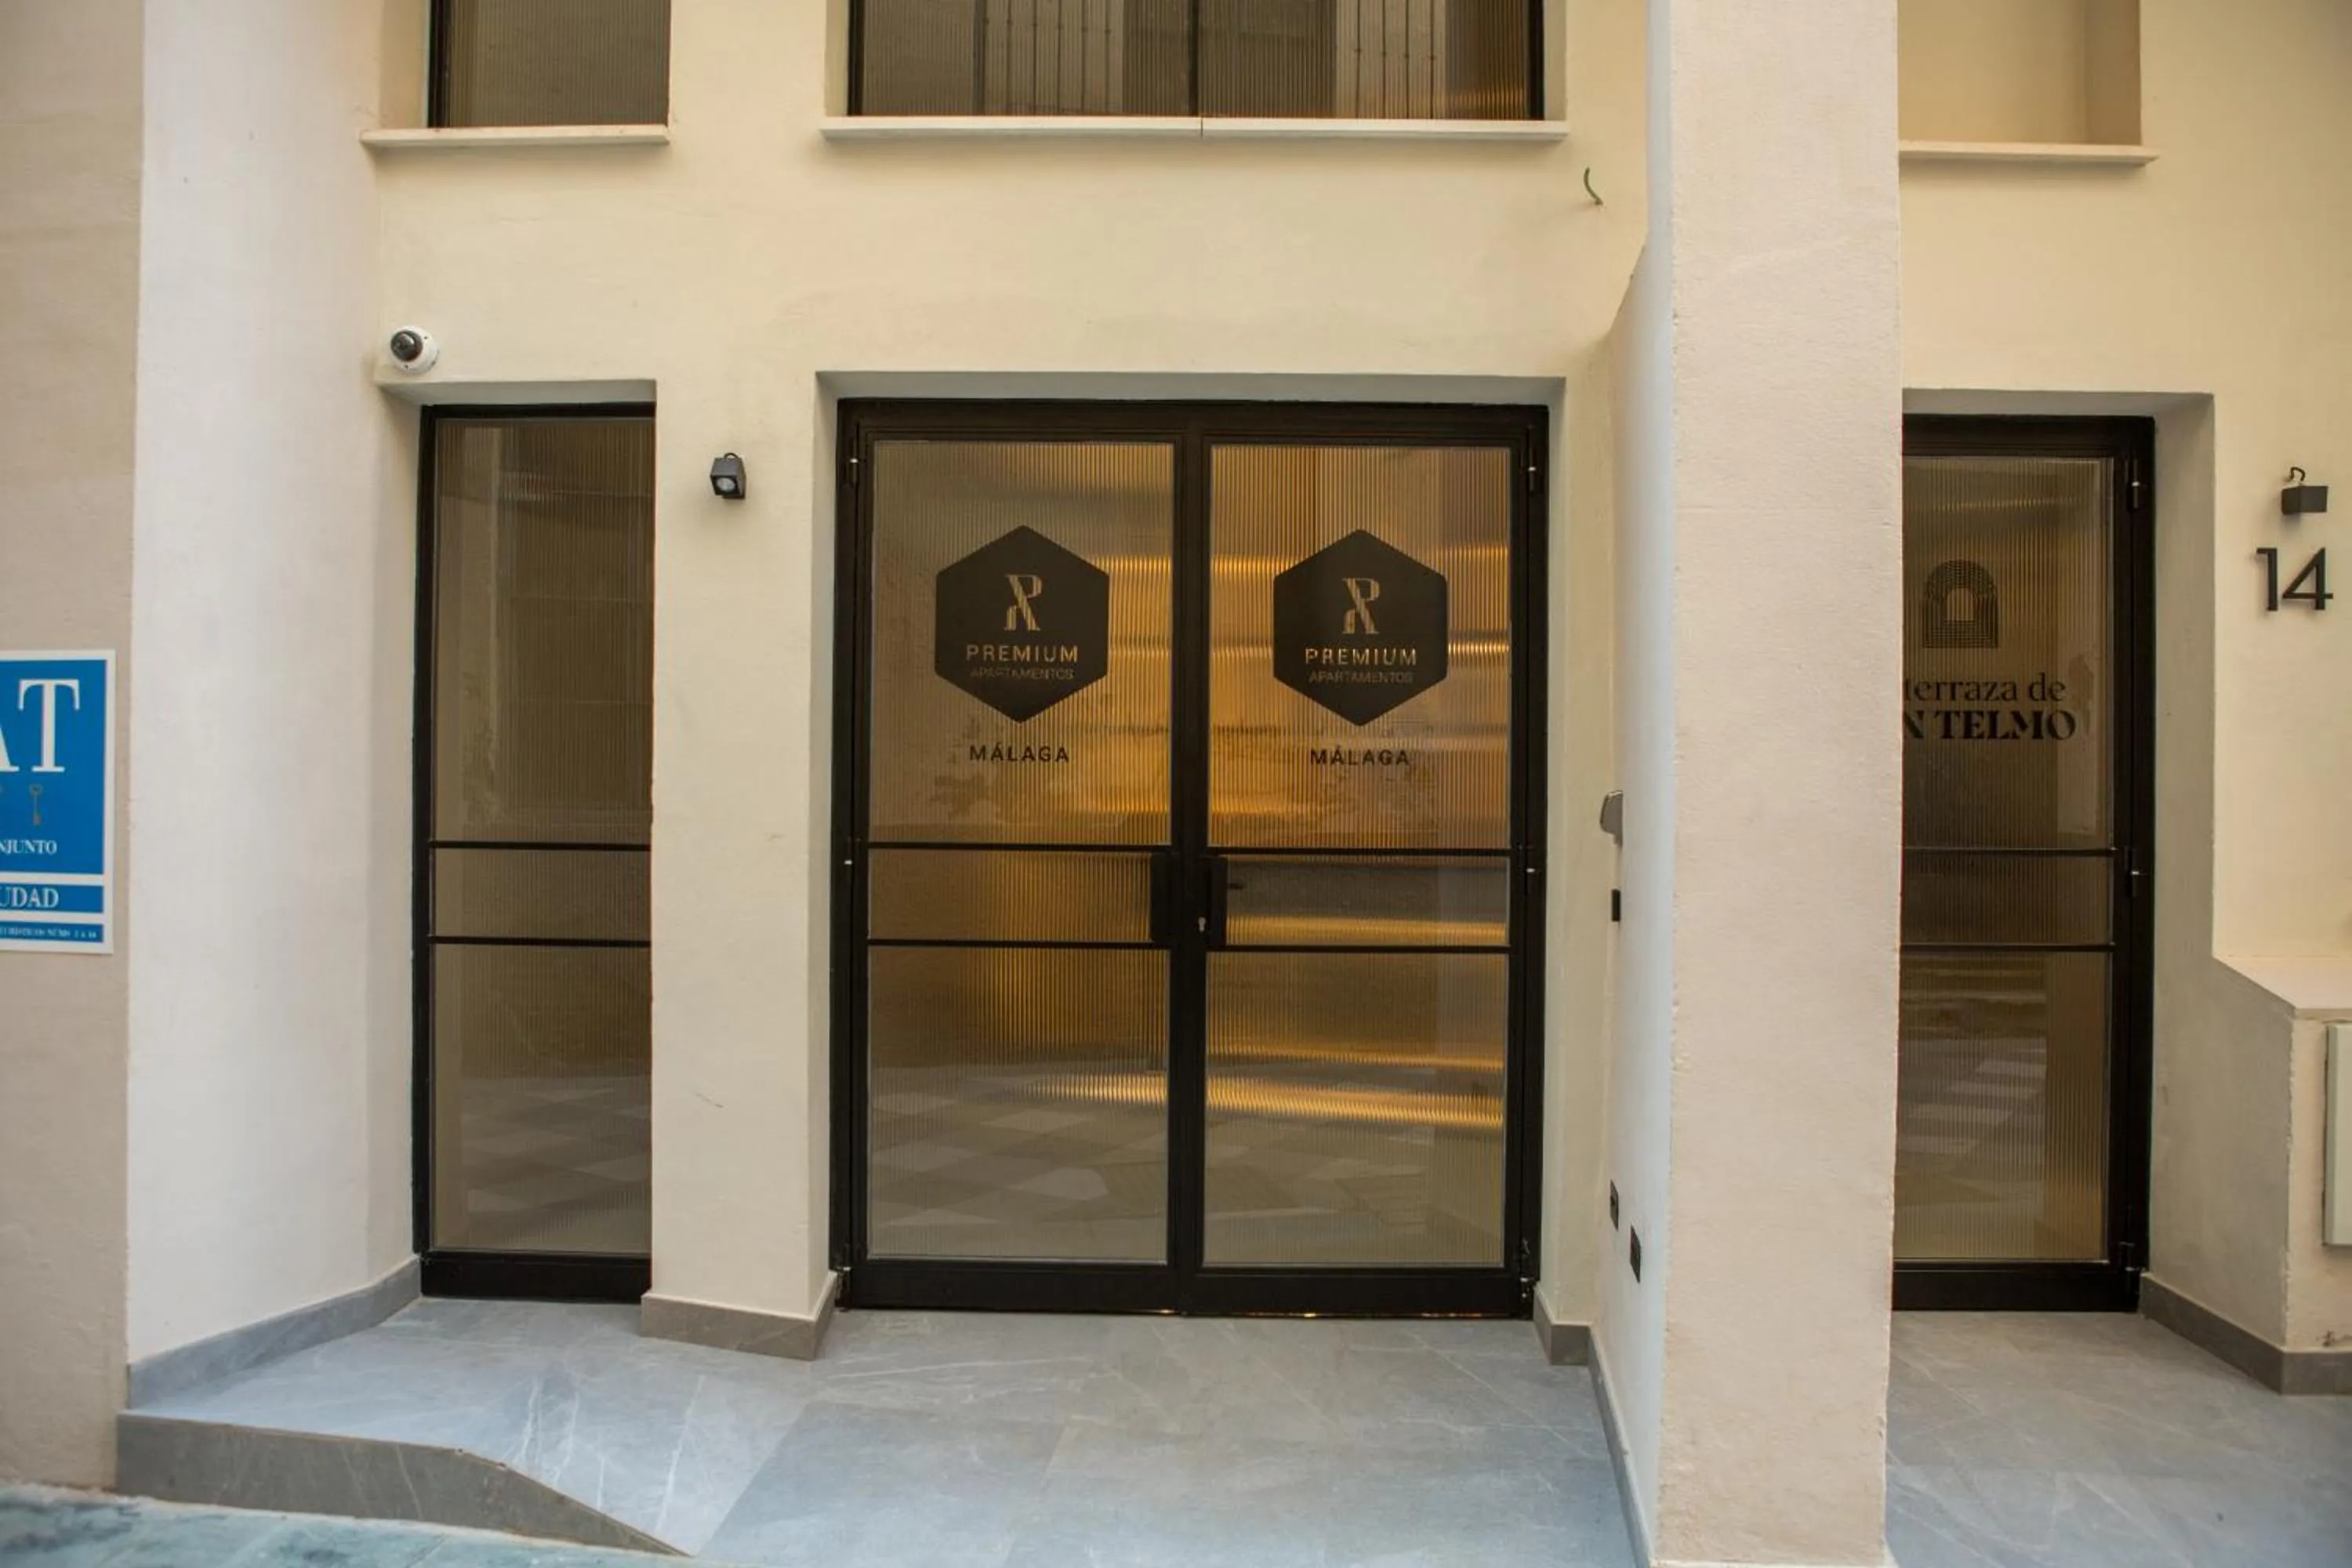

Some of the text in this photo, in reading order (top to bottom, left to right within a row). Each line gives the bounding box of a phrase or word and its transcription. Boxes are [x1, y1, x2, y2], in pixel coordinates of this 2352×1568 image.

[2256, 547, 2334, 612] 14
[966, 644, 1079, 662] PREMIUM
[1305, 648, 1417, 666] PREMIUM
[1308, 670, 1413, 684] APARTAMENTOS
[2027, 672, 2066, 702] de
[1934, 709, 2076, 740] TELMO
[969, 742, 1069, 762] MÁLAGA
[1310, 746, 1411, 766] MÁLAGA
